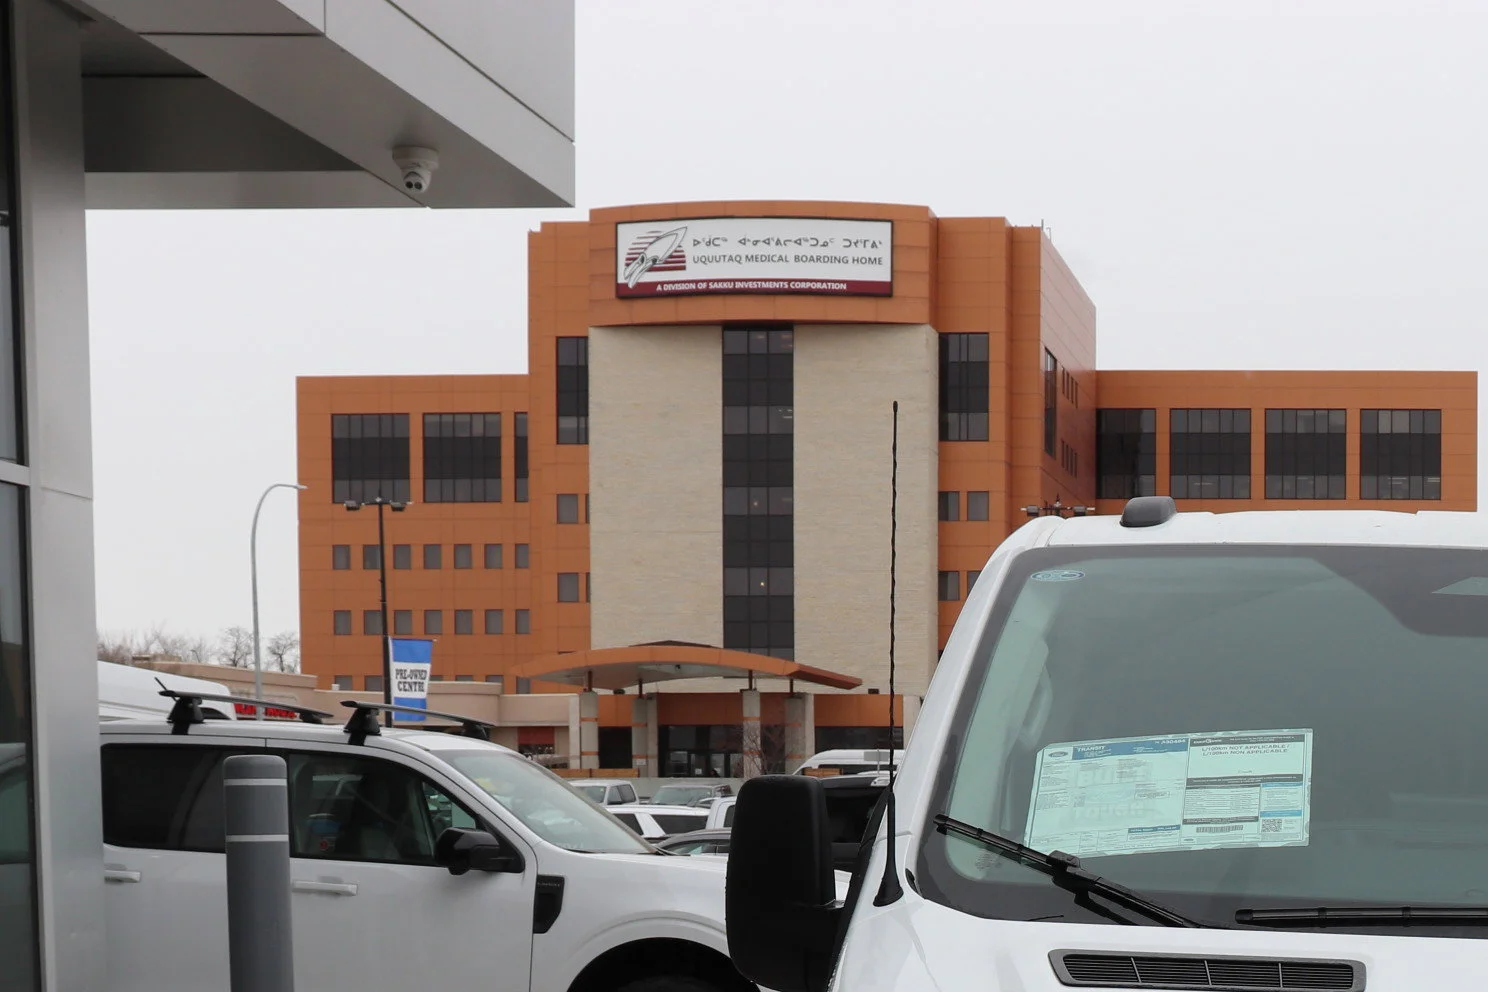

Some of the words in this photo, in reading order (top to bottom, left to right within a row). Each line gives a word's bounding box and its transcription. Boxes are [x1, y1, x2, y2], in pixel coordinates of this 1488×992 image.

[692, 254, 742, 265] UQUUTAQ
[745, 254, 790, 263] MEDICAL
[794, 254, 849, 265] BOARDING
[852, 256, 883, 265] HOME
[663, 282, 696, 291] DIVISION
[697, 281, 707, 289] OF
[709, 281, 734, 289] SAKKU
[735, 281, 788, 289] INVESTMENTS
[790, 281, 847, 290] CORPORATION
[395, 669, 427, 680] PRE-OWNED
